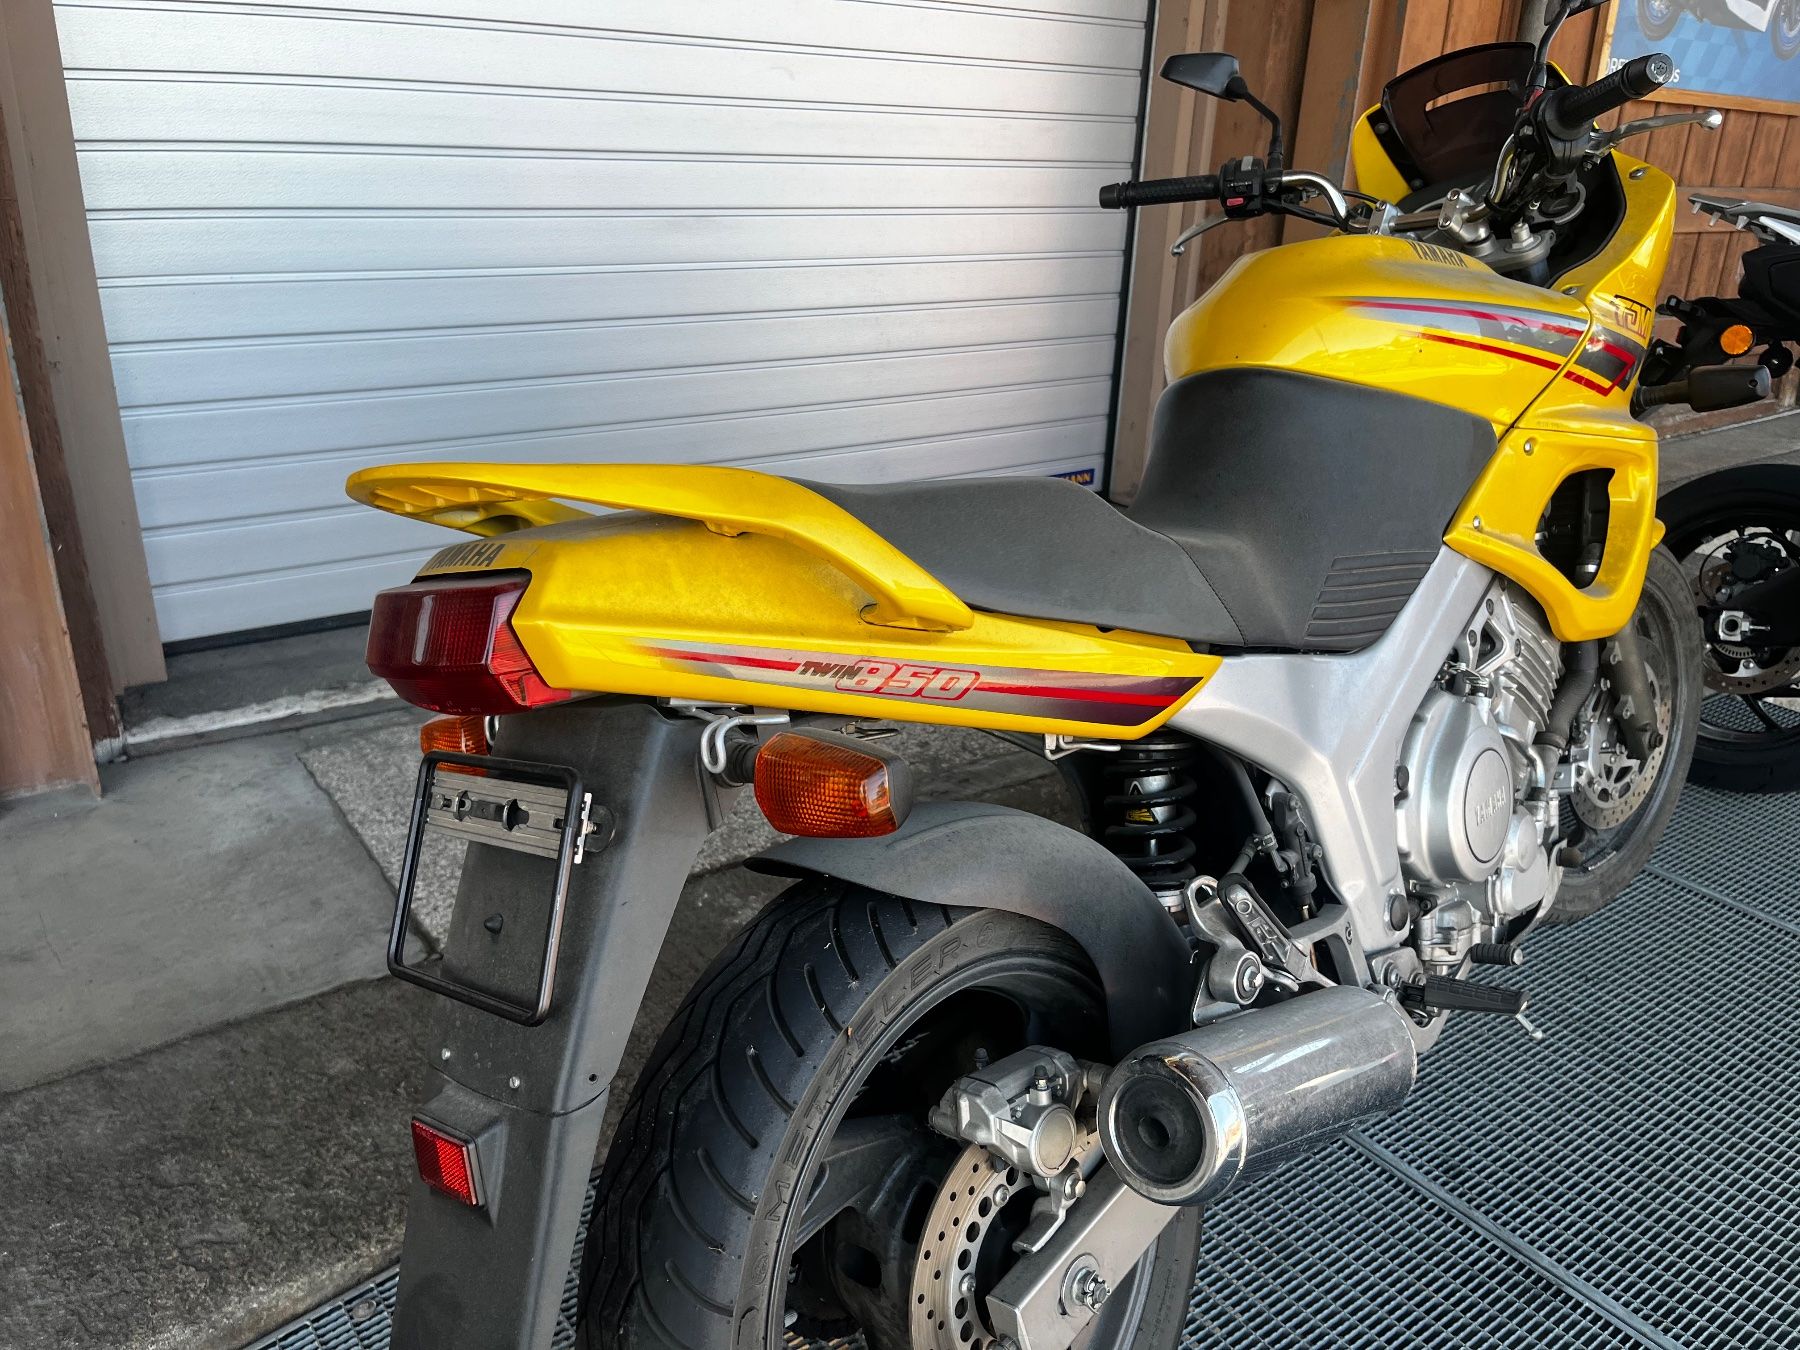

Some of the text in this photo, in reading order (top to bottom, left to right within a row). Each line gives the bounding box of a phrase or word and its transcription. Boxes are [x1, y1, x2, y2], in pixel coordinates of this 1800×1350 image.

[1405, 239, 1469, 268] YAMAHA
[799, 659, 981, 701] TWIN 850
